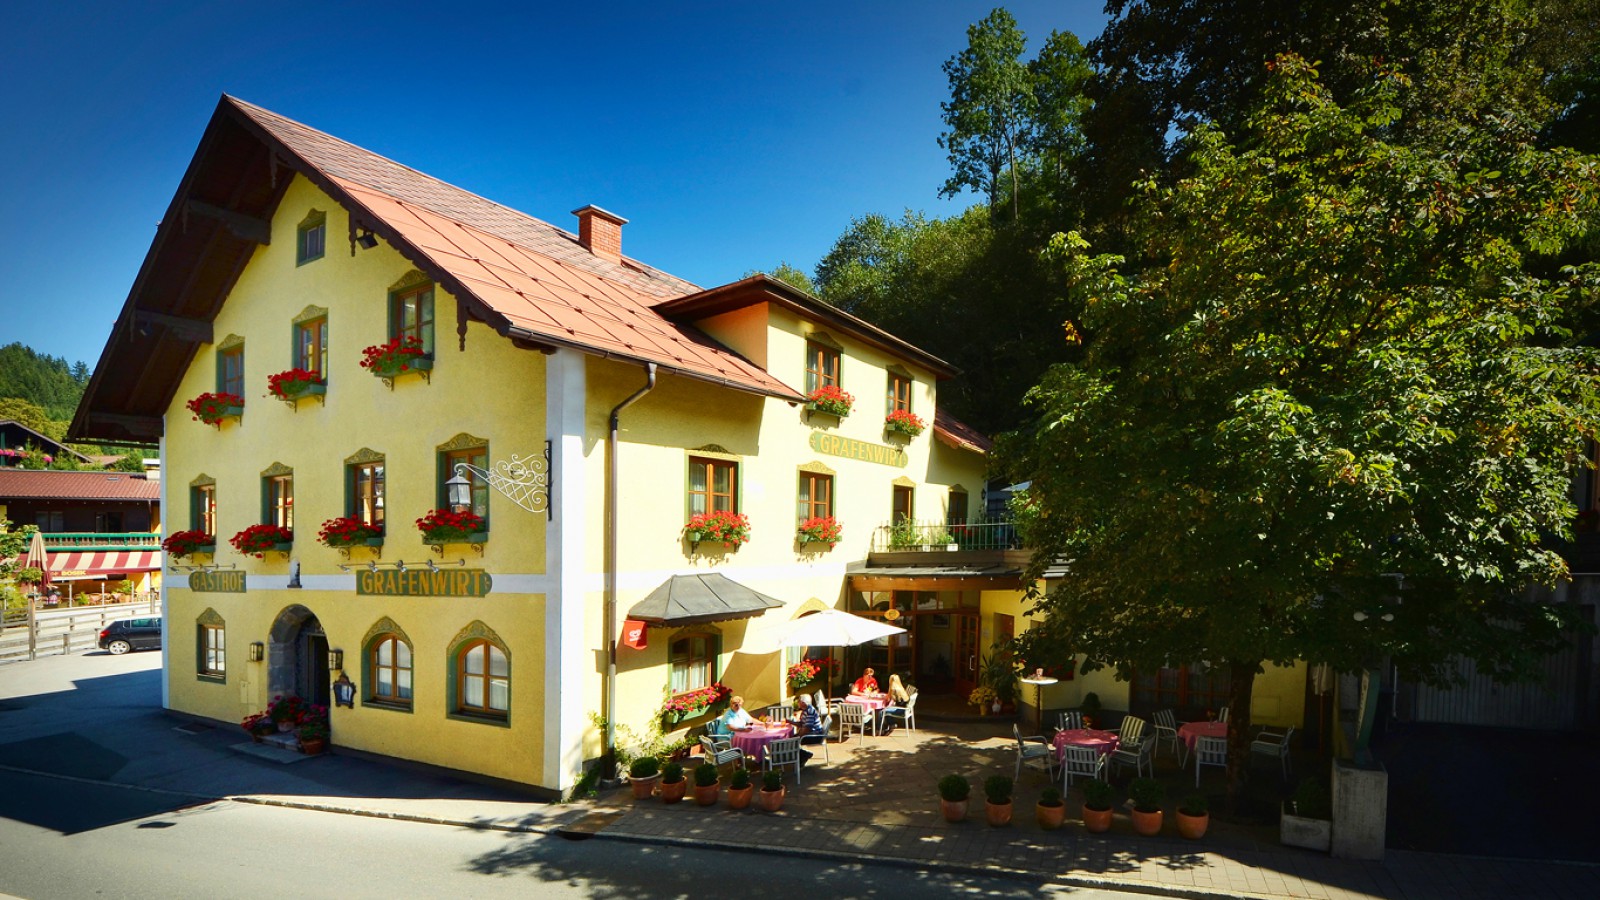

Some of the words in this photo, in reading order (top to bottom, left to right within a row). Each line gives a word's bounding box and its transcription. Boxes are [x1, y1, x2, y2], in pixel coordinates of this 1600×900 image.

[820, 434, 904, 466] GRAFENWIRT
[192, 572, 244, 592] GASTHOF
[361, 570, 482, 595] GRAFENWIRT
